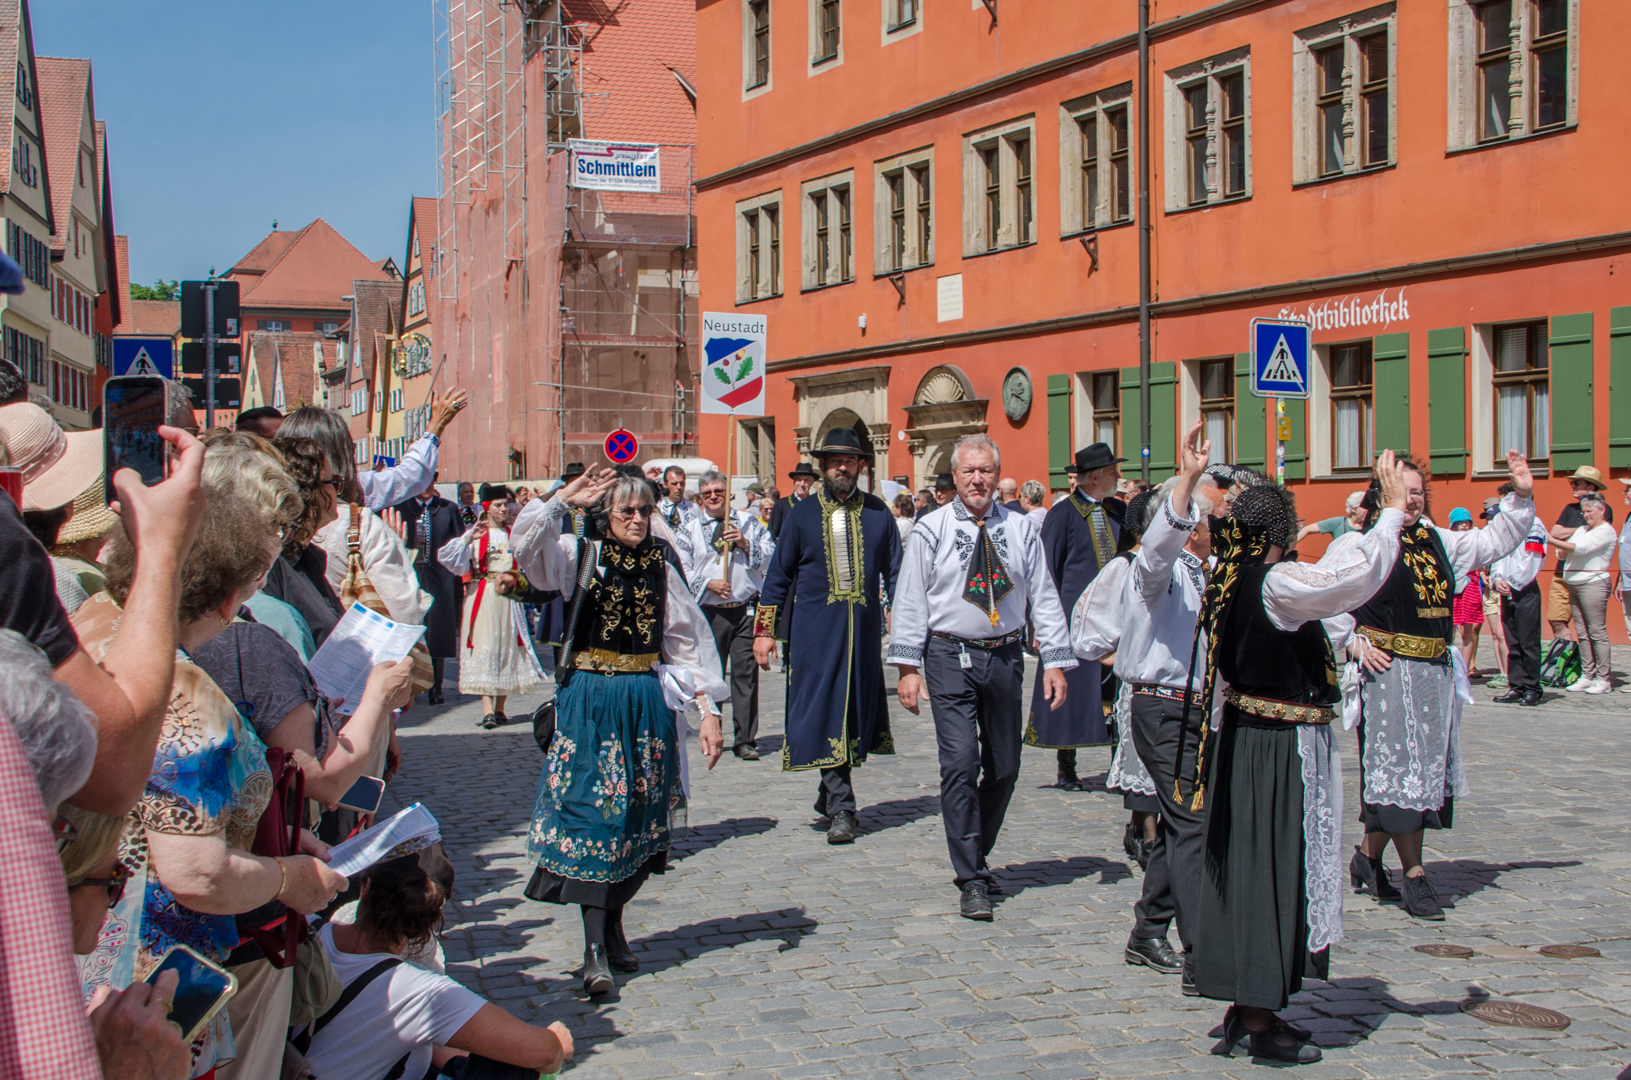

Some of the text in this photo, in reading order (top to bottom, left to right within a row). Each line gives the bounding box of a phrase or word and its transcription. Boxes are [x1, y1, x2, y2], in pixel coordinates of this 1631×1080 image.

[578, 159, 656, 177] Schmittlein
[1278, 285, 1410, 331] Stadtbibliothek
[704, 319, 765, 334] Neustadt
